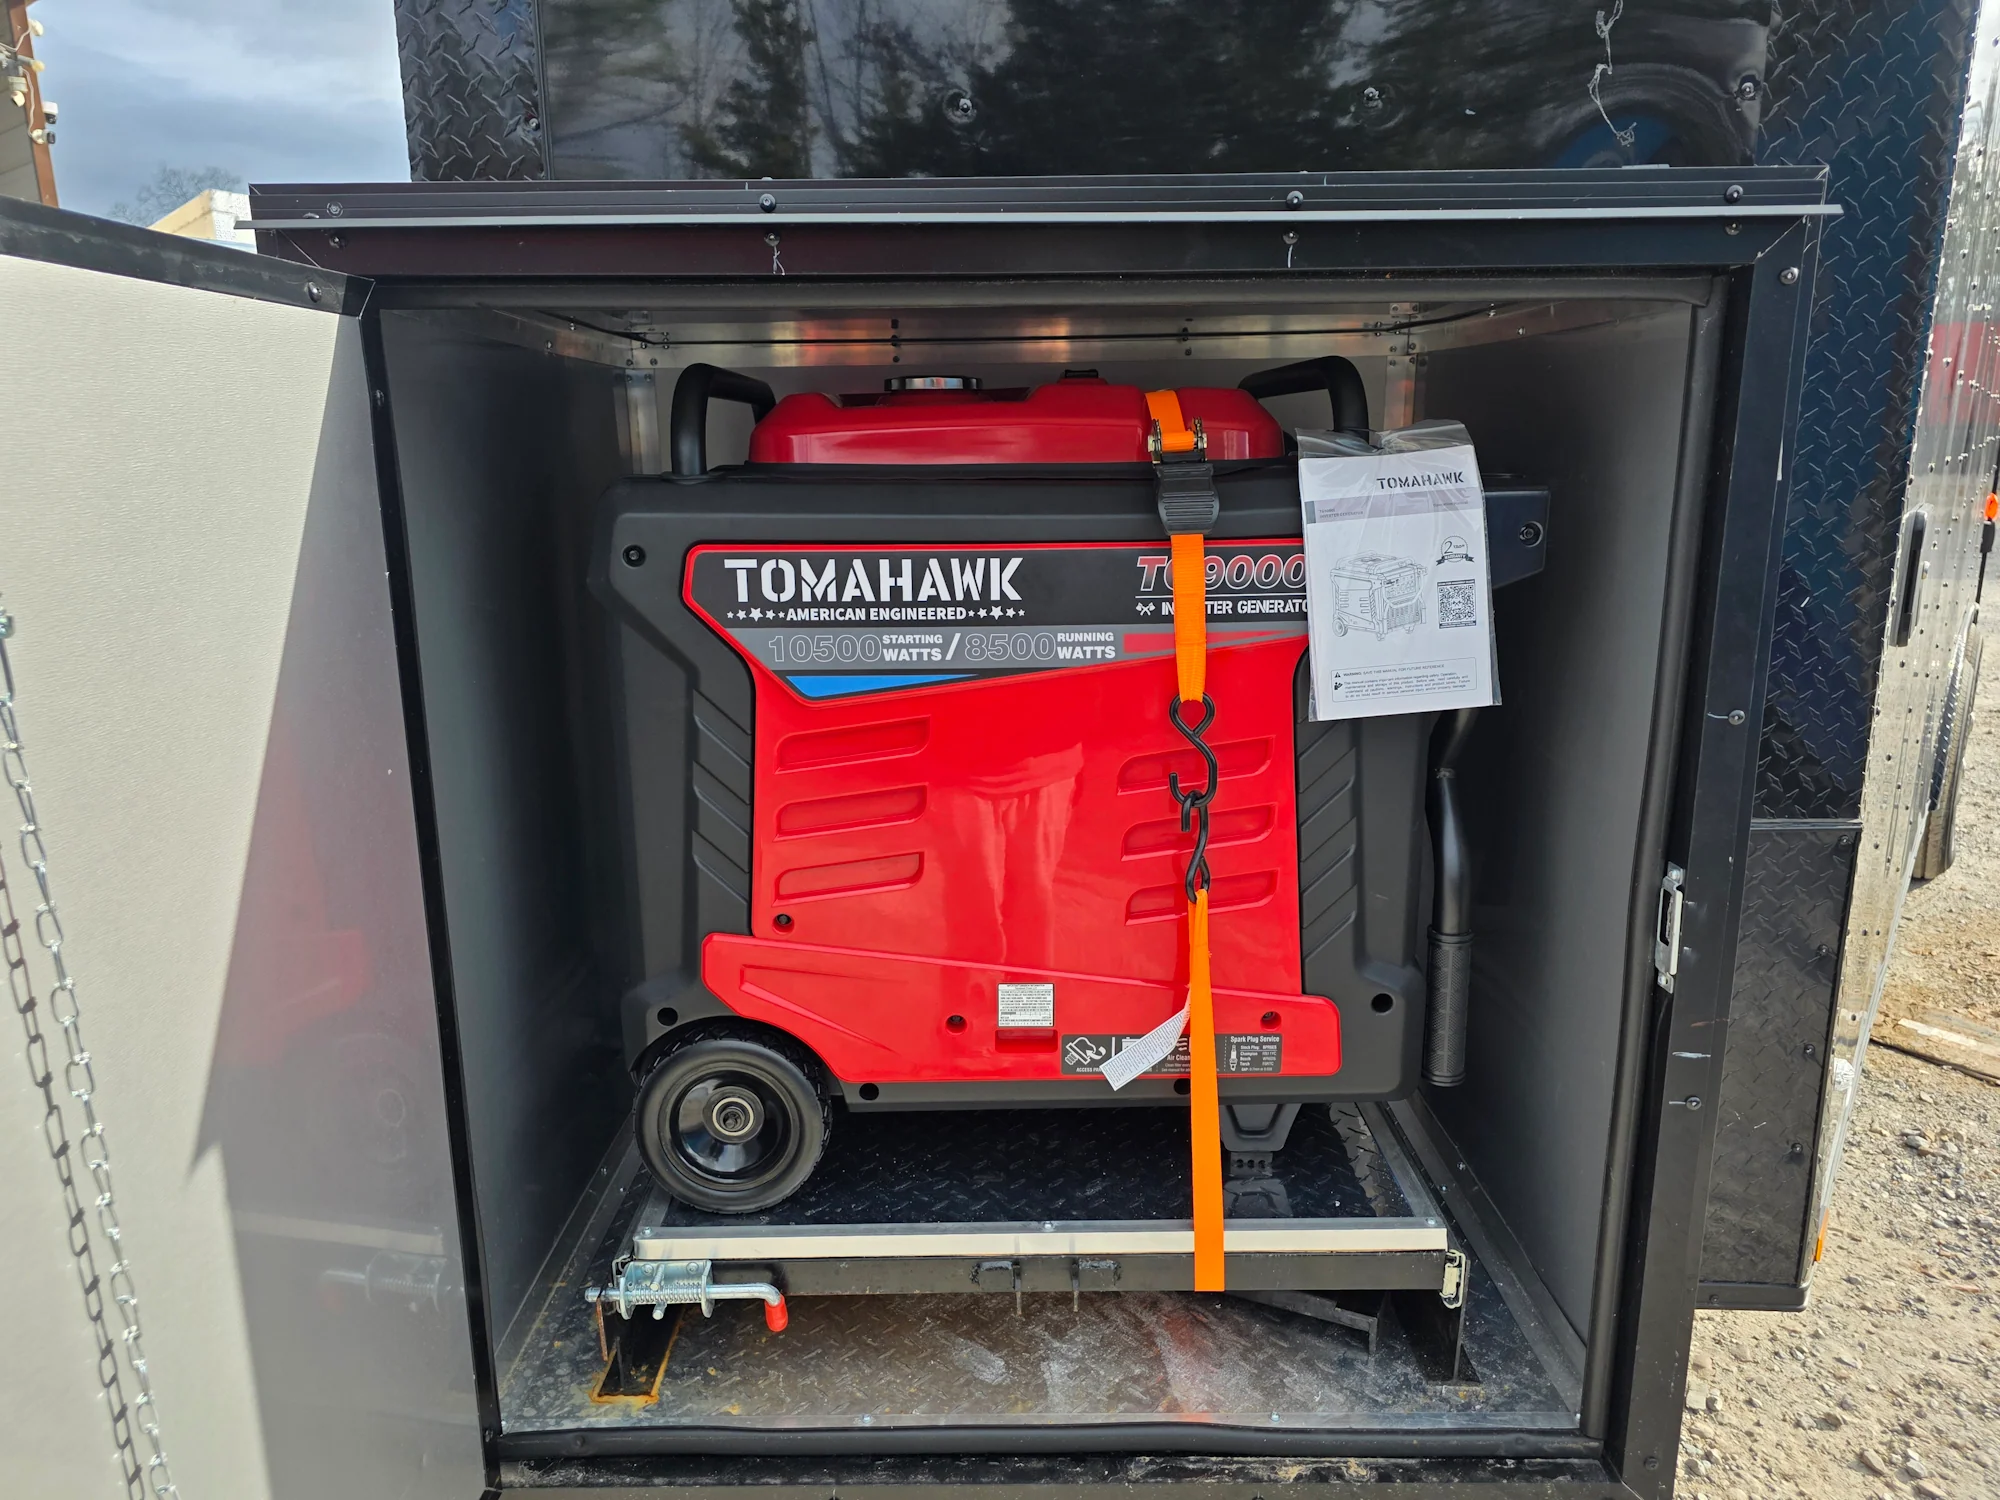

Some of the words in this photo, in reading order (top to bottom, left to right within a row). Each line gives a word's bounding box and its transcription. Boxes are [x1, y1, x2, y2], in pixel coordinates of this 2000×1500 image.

[1376, 472, 1465, 490] TOMAHAWK
[1444, 540, 1453, 554] 2
[724, 557, 1024, 603] TOMAHAWK
[787, 607, 866, 622] AMERICAN
[870, 606, 966, 621] ENGINEERED
[1161, 600, 1232, 616] INTER
[1237, 599, 1308, 614] GENERATO
[882, 633, 943, 645] STARTING
[1057, 631, 1115, 643] RUNNING
[768, 634, 882, 662] 10500
[964, 632, 1056, 661] 8500
[1057, 645, 1116, 660] WATTS
[882, 648, 942, 662] WATTS
